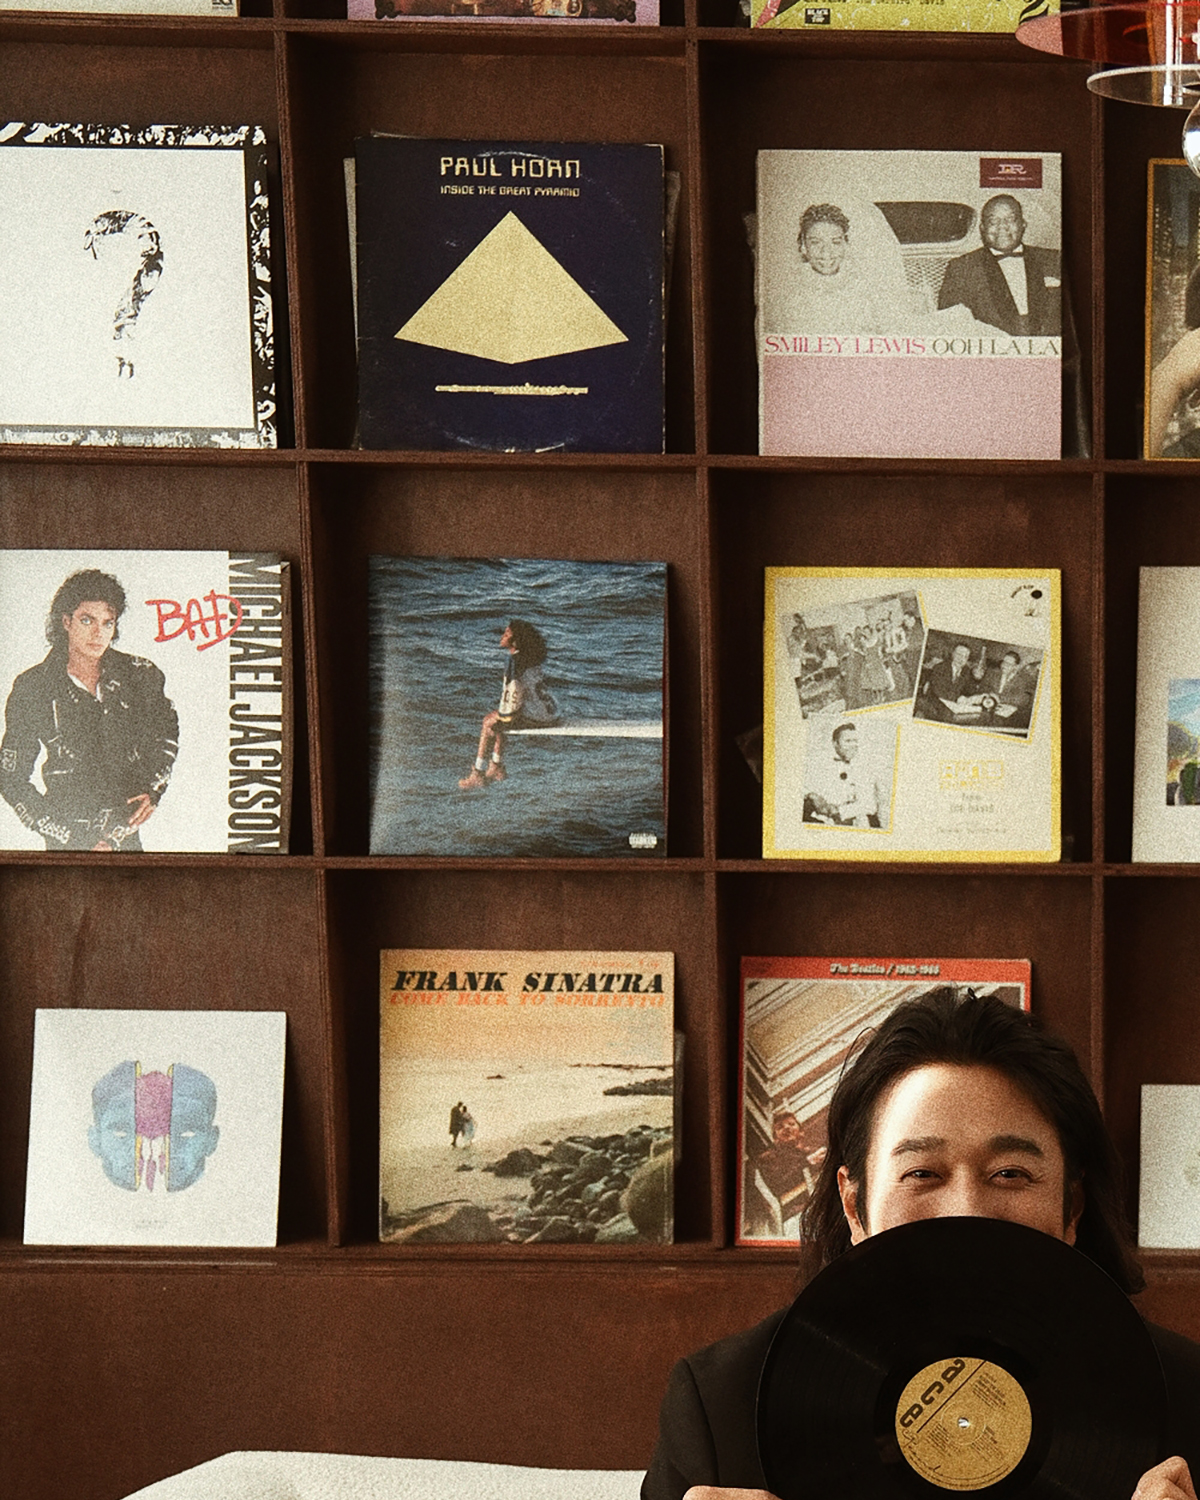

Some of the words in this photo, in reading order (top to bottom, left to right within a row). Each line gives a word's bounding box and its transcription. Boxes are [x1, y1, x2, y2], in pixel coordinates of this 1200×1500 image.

[440, 157, 503, 177] PAUL
[511, 158, 580, 179] HORN
[440, 185, 474, 195] INSIDE
[477, 186, 497, 195] THE
[499, 186, 531, 196] GREAT
[534, 187, 580, 198] PYRAMID
[764, 336, 847, 353] SMILEY
[854, 337, 926, 354] LEWIS
[932, 338, 986, 354] OOH
[991, 338, 1023, 355] LA
[1028, 338, 1061, 355] LA
[145, 589, 243, 651] BAD
[228, 551, 282, 693] MICHAEL
[227, 703, 282, 853] JACKSON
[391, 970, 508, 992] FRANK
[522, 972, 665, 994] SINATRA
[390, 992, 450, 1006] COME
[456, 992, 510, 1006] BACK
[520, 993, 547, 1006] TO
[553, 993, 666, 1008] SORRENTO
